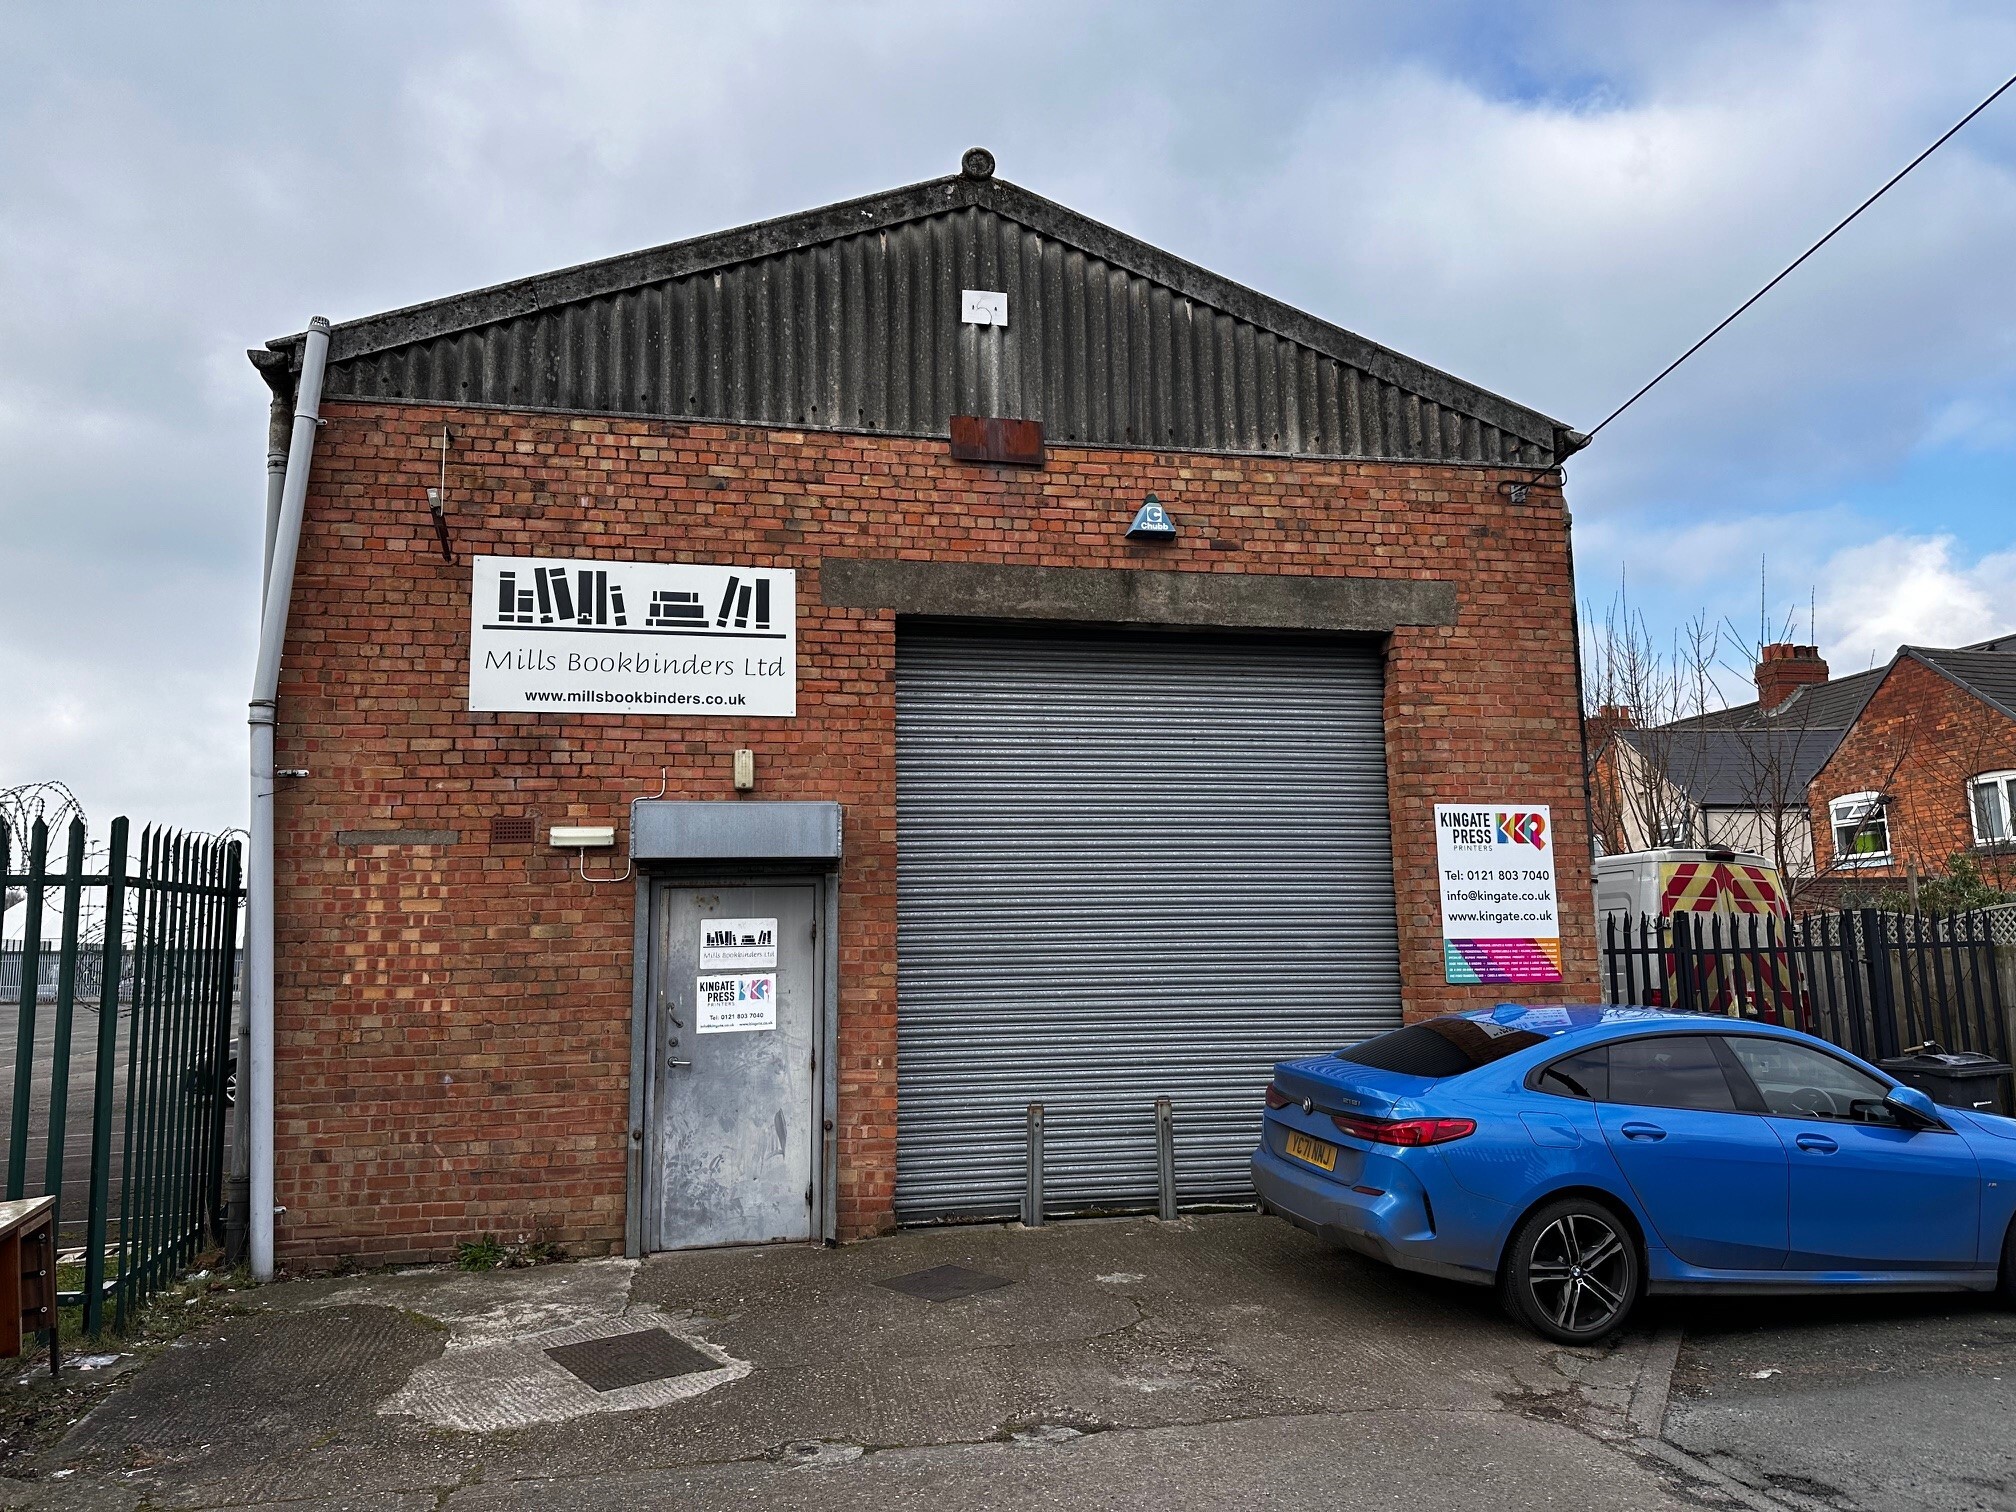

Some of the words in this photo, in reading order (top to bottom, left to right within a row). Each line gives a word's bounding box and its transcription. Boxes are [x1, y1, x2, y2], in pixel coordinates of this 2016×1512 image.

[1141, 522, 1169, 530] Chubb
[485, 649, 557, 671] Mills
[568, 652, 734, 676] Bookbinders
[744, 656, 786, 677] Ltd
[525, 690, 746, 706] www.millsbookbinders.co.uk
[1440, 812, 1490, 827] KINGATE
[1453, 829, 1492, 843] PRESS
[1445, 870, 1464, 880] Tel:
[1467, 870, 1494, 880] 0121
[1498, 870, 1519, 880] 803
[1523, 870, 1549, 880] 7040
[1447, 890, 1551, 903] info@kingate.co.uk
[1448, 911, 1552, 923] www.kingate.co.uk
[700, 981, 735, 992] KINGATE
[707, 992, 735, 1002] PRESS
